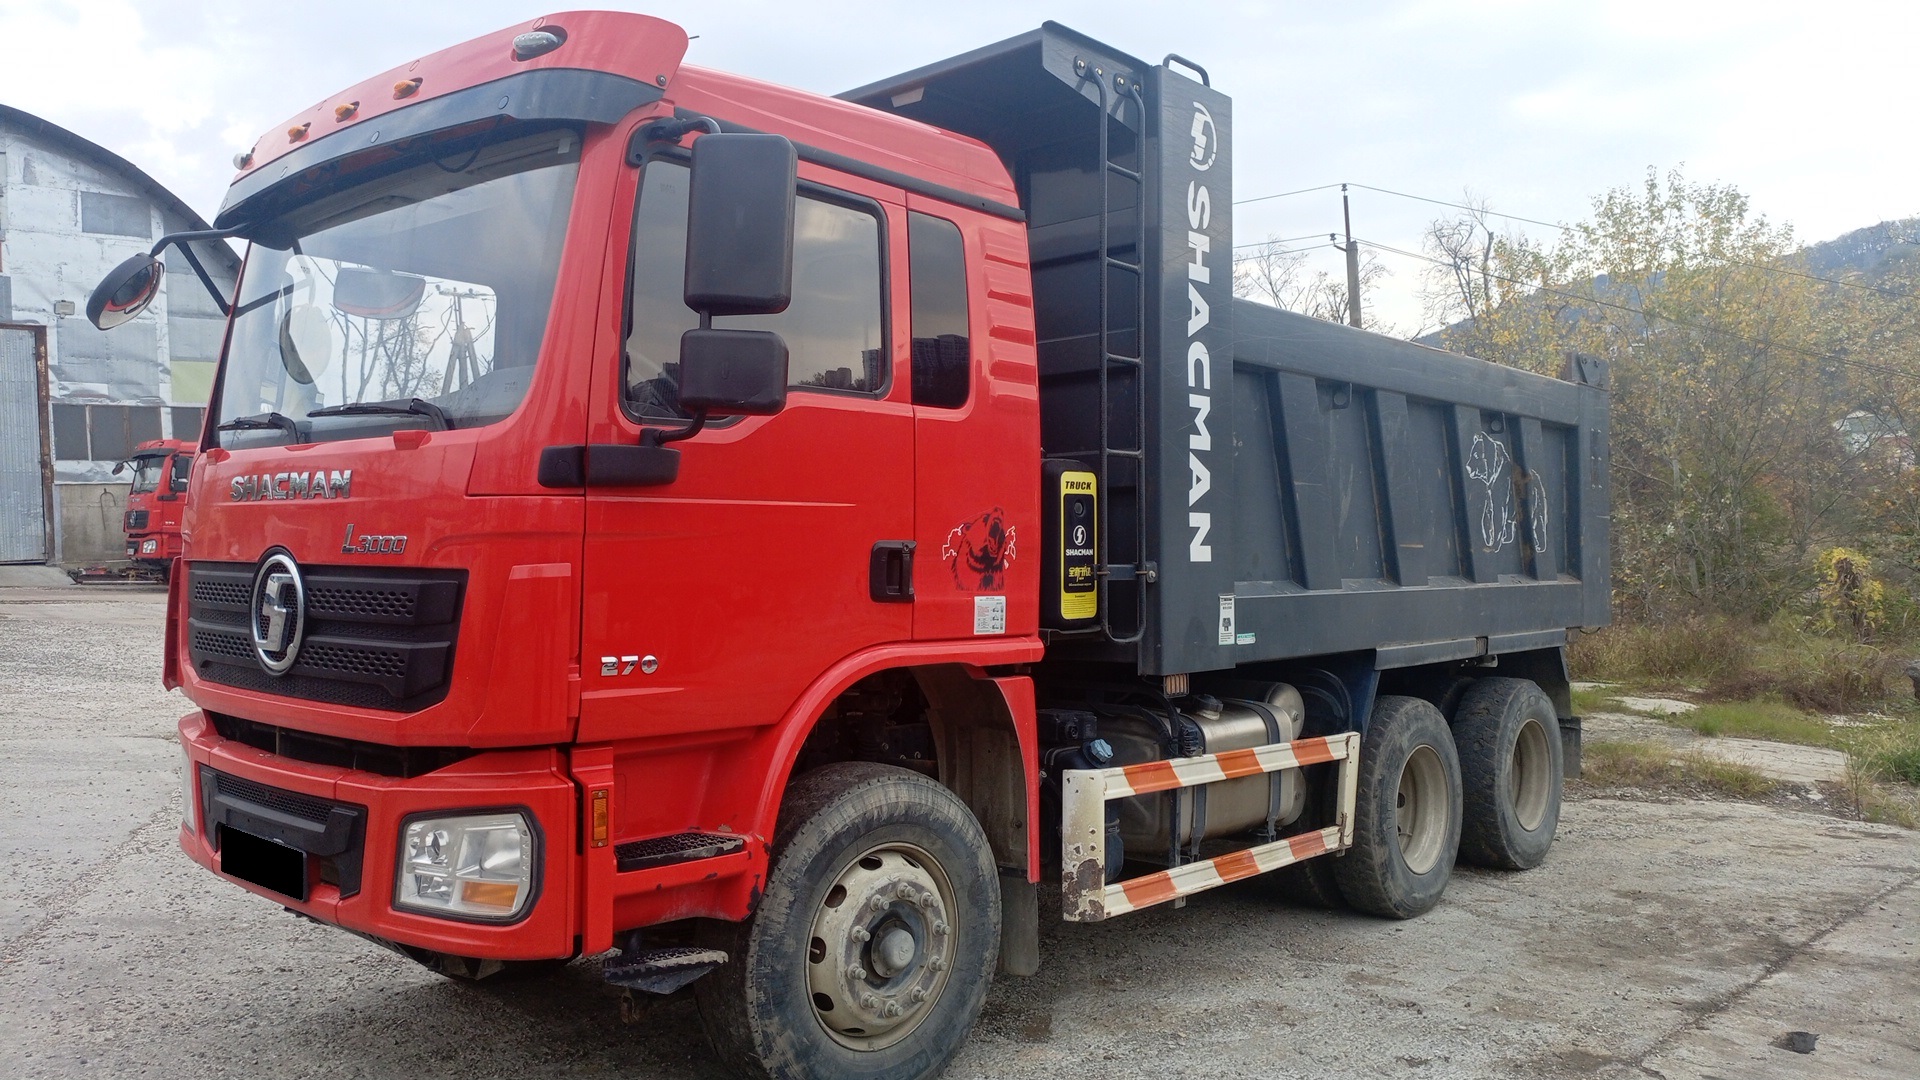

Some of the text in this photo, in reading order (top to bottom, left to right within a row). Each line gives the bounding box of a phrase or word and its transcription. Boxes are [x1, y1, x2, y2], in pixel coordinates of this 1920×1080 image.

[1187, 180, 1212, 562] SHACMAN
[230, 470, 353, 502] SHACMAN
[1065, 481, 1092, 490] TRUCK
[341, 524, 407, 554] L3000
[1065, 548, 1094, 556] SHACMAN
[601, 655, 658, 677] 270
